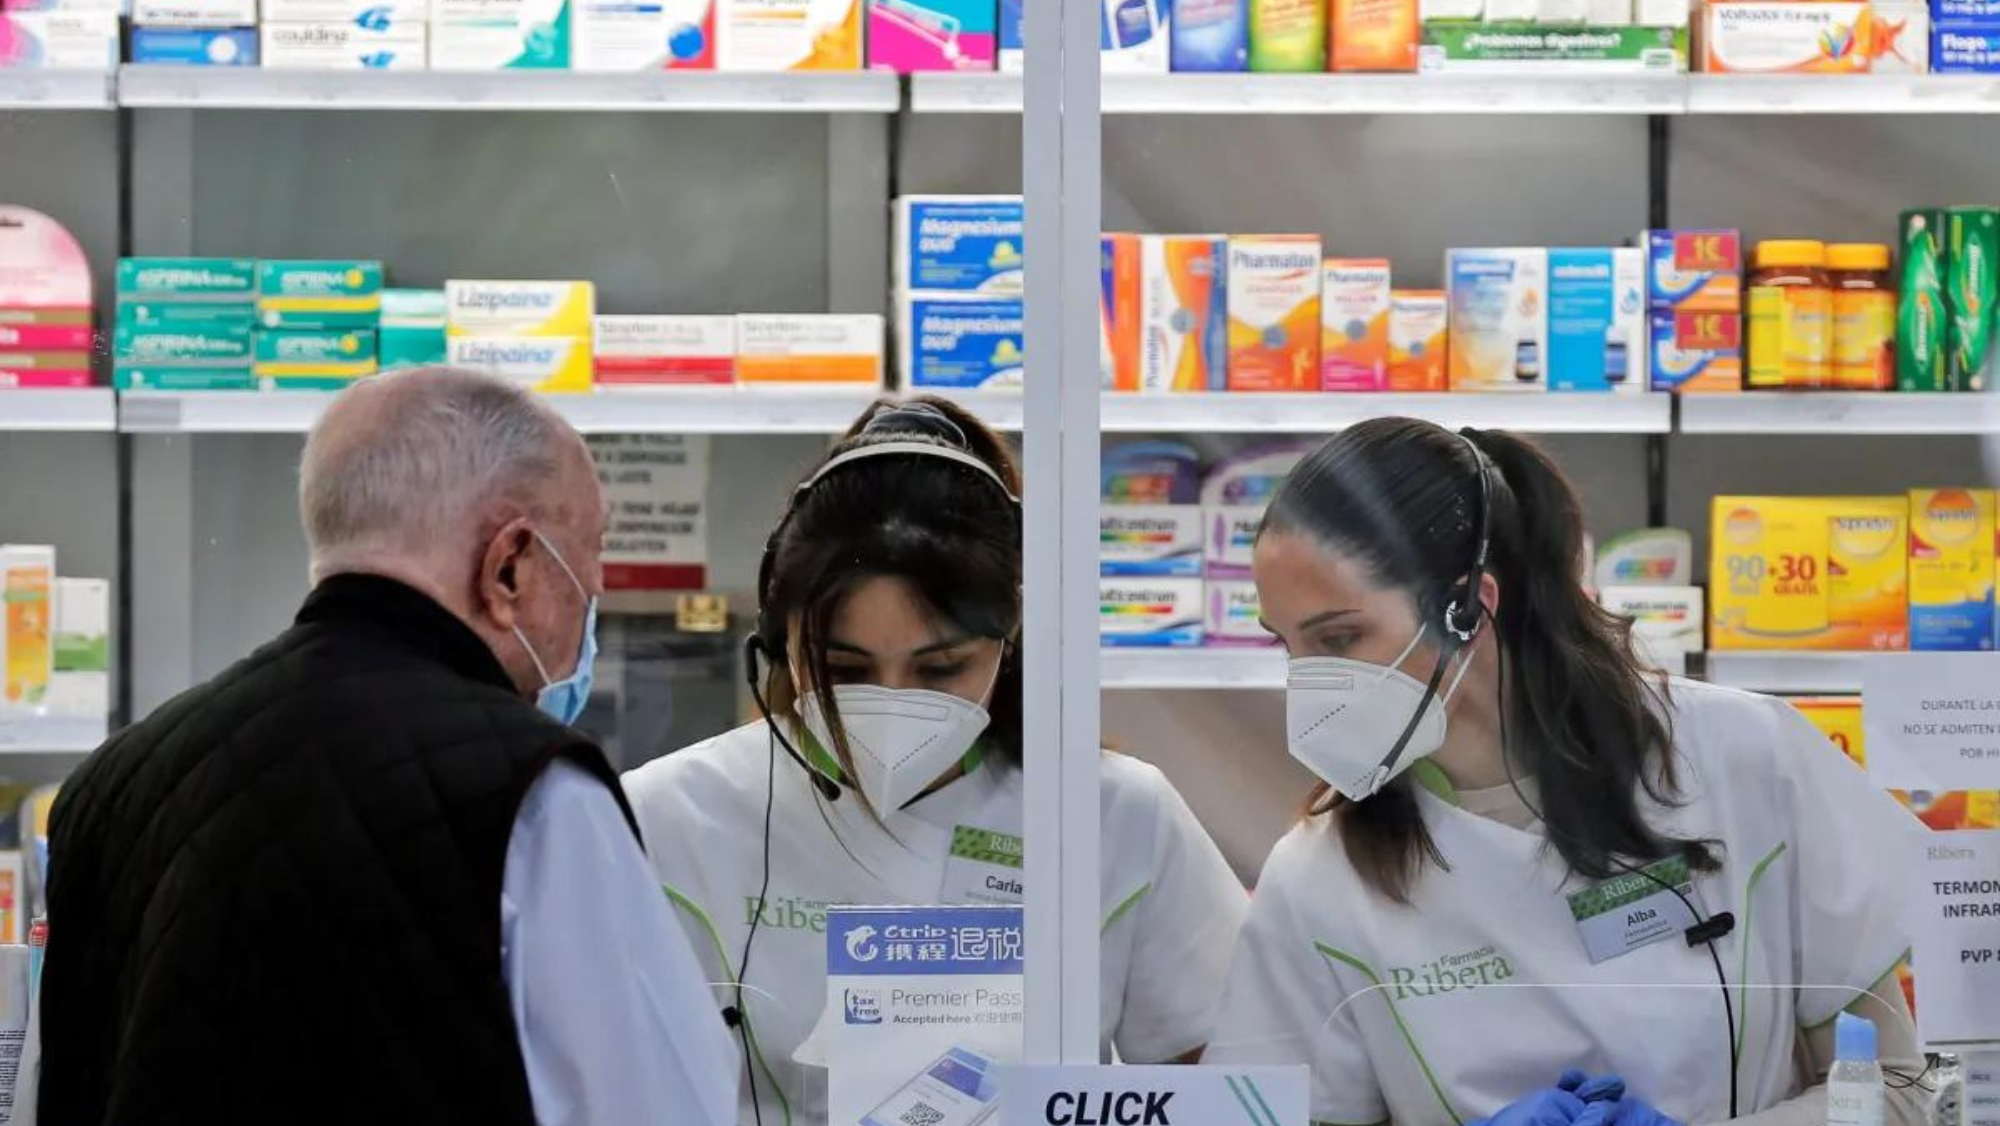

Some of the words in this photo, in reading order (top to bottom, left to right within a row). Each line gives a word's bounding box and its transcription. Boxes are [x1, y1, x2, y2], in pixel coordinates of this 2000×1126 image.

[1921, 700, 1976, 711] DURANTE
[1980, 700, 1994, 711] LA
[1903, 723, 1920, 735] NO
[1924, 723, 1937, 735] SE
[1941, 723, 1995, 735] ADMITEN
[1959, 748, 1983, 759] POR
[986, 875, 1023, 895] Carla
[1627, 908, 1657, 926] Alba
[884, 924, 947, 939] Ctrip
[950, 926, 1024, 961] 退税
[1439, 945, 1495, 966] Farmacia
[1960, 949, 1993, 963] PVP
[1387, 956, 1514, 999] Ribera
[852, 995, 875, 1006] tax
[891, 988, 969, 1007] Premier
[976, 988, 1022, 1006] Pass
[852, 1006, 880, 1019] free
[892, 1014, 944, 1026] Accepted
[946, 1014, 971, 1025] here
[1045, 1091, 1175, 1126] CLICK
